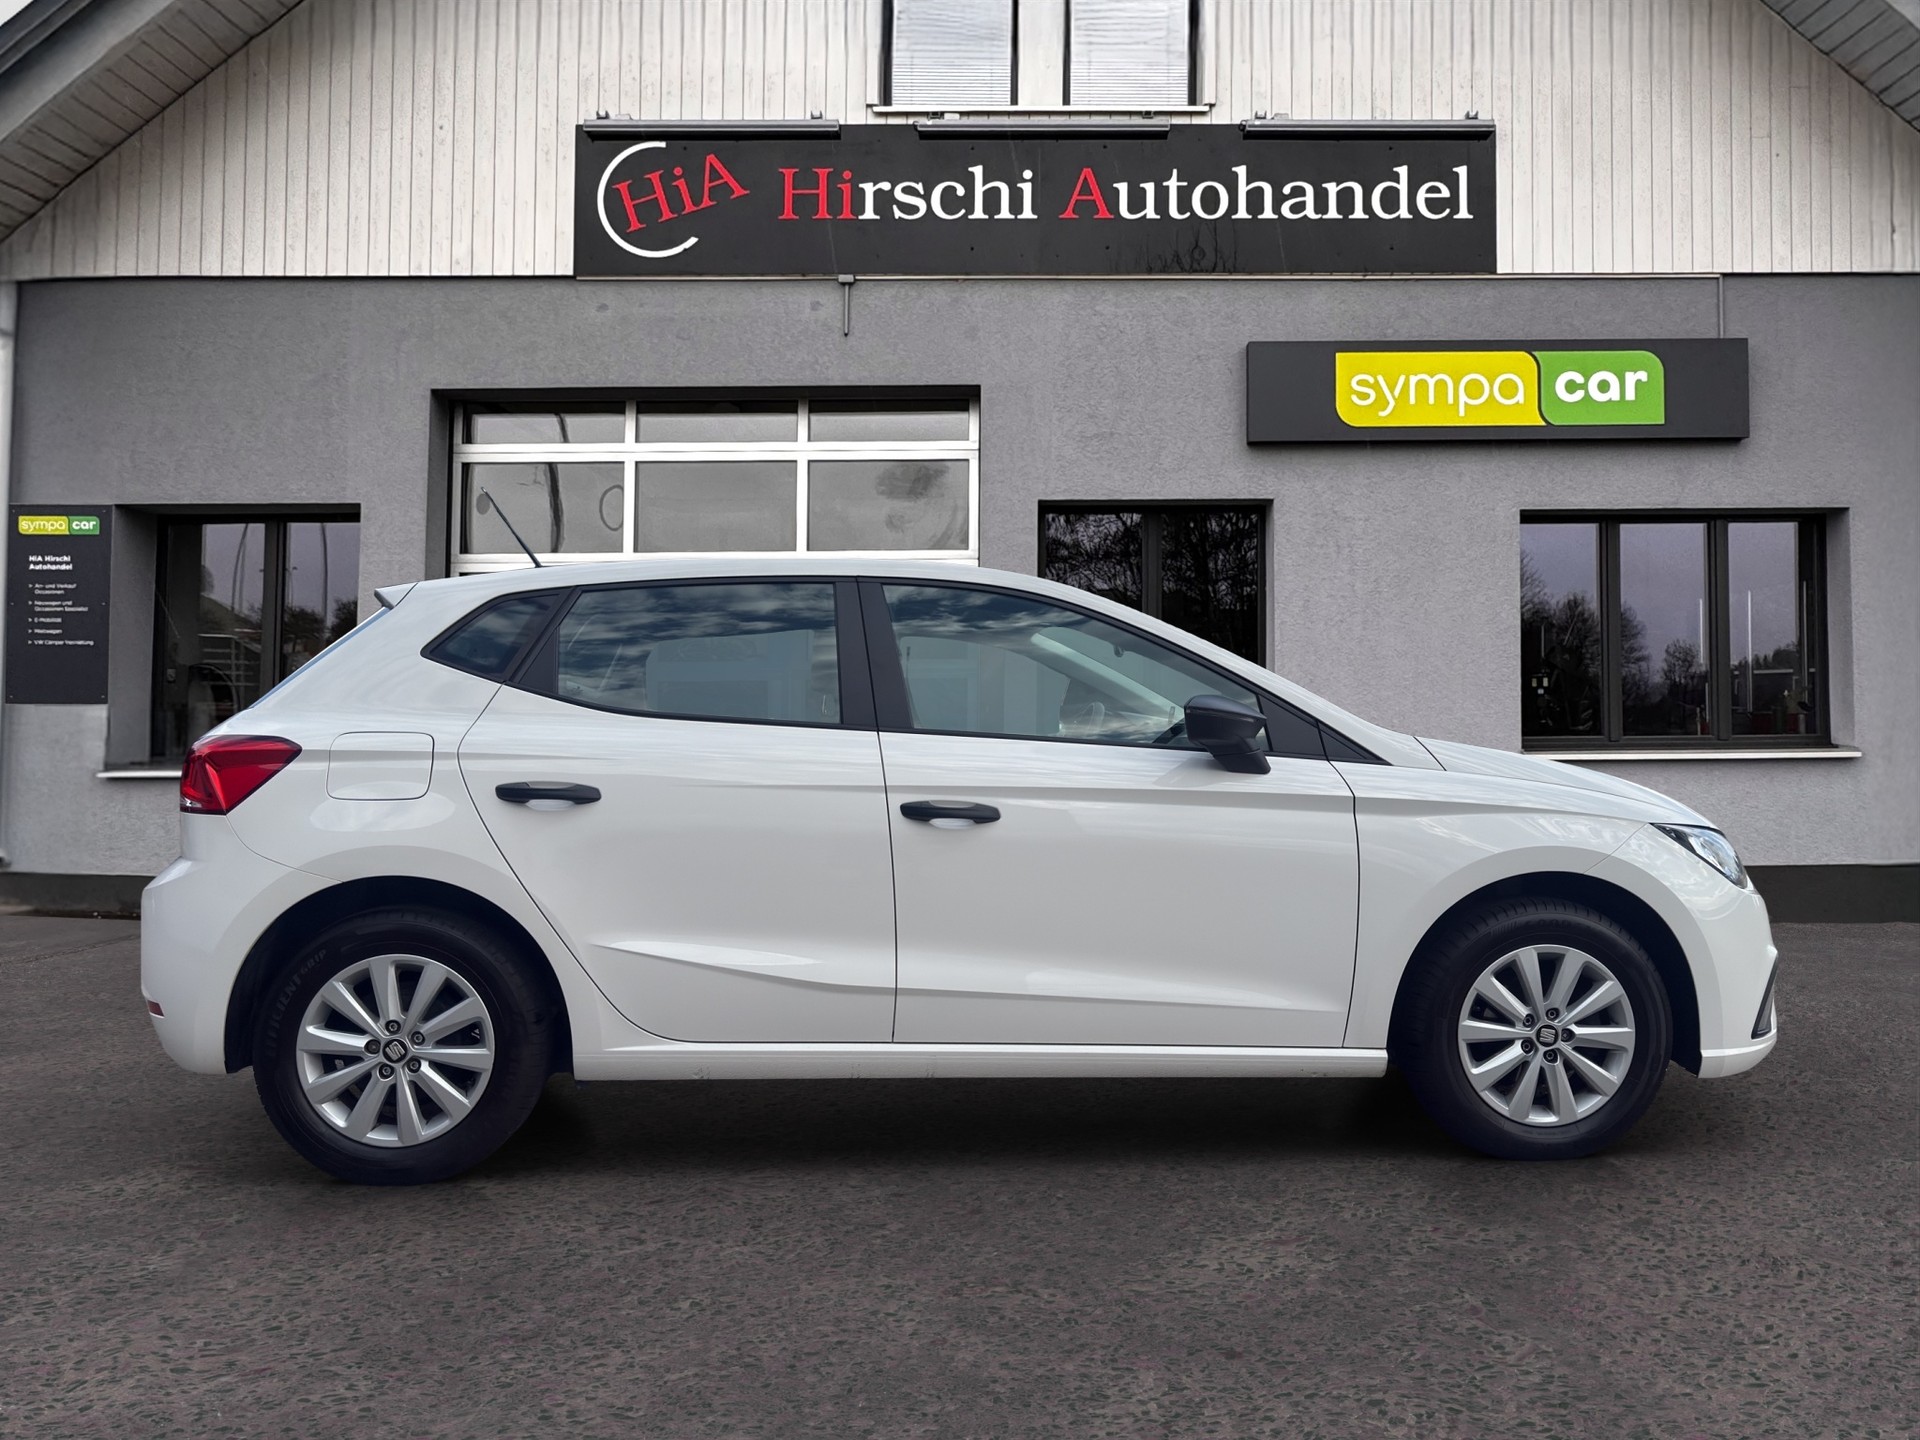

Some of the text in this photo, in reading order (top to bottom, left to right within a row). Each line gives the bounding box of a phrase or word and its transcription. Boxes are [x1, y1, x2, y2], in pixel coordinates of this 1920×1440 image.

[612, 153, 750, 233] HiA
[778, 165, 1474, 220] Hirschi Autohandel
[1350, 369, 1648, 417] sympa car
[21, 520, 96, 532] sympa car
[29, 563, 73, 571] Autohandel
